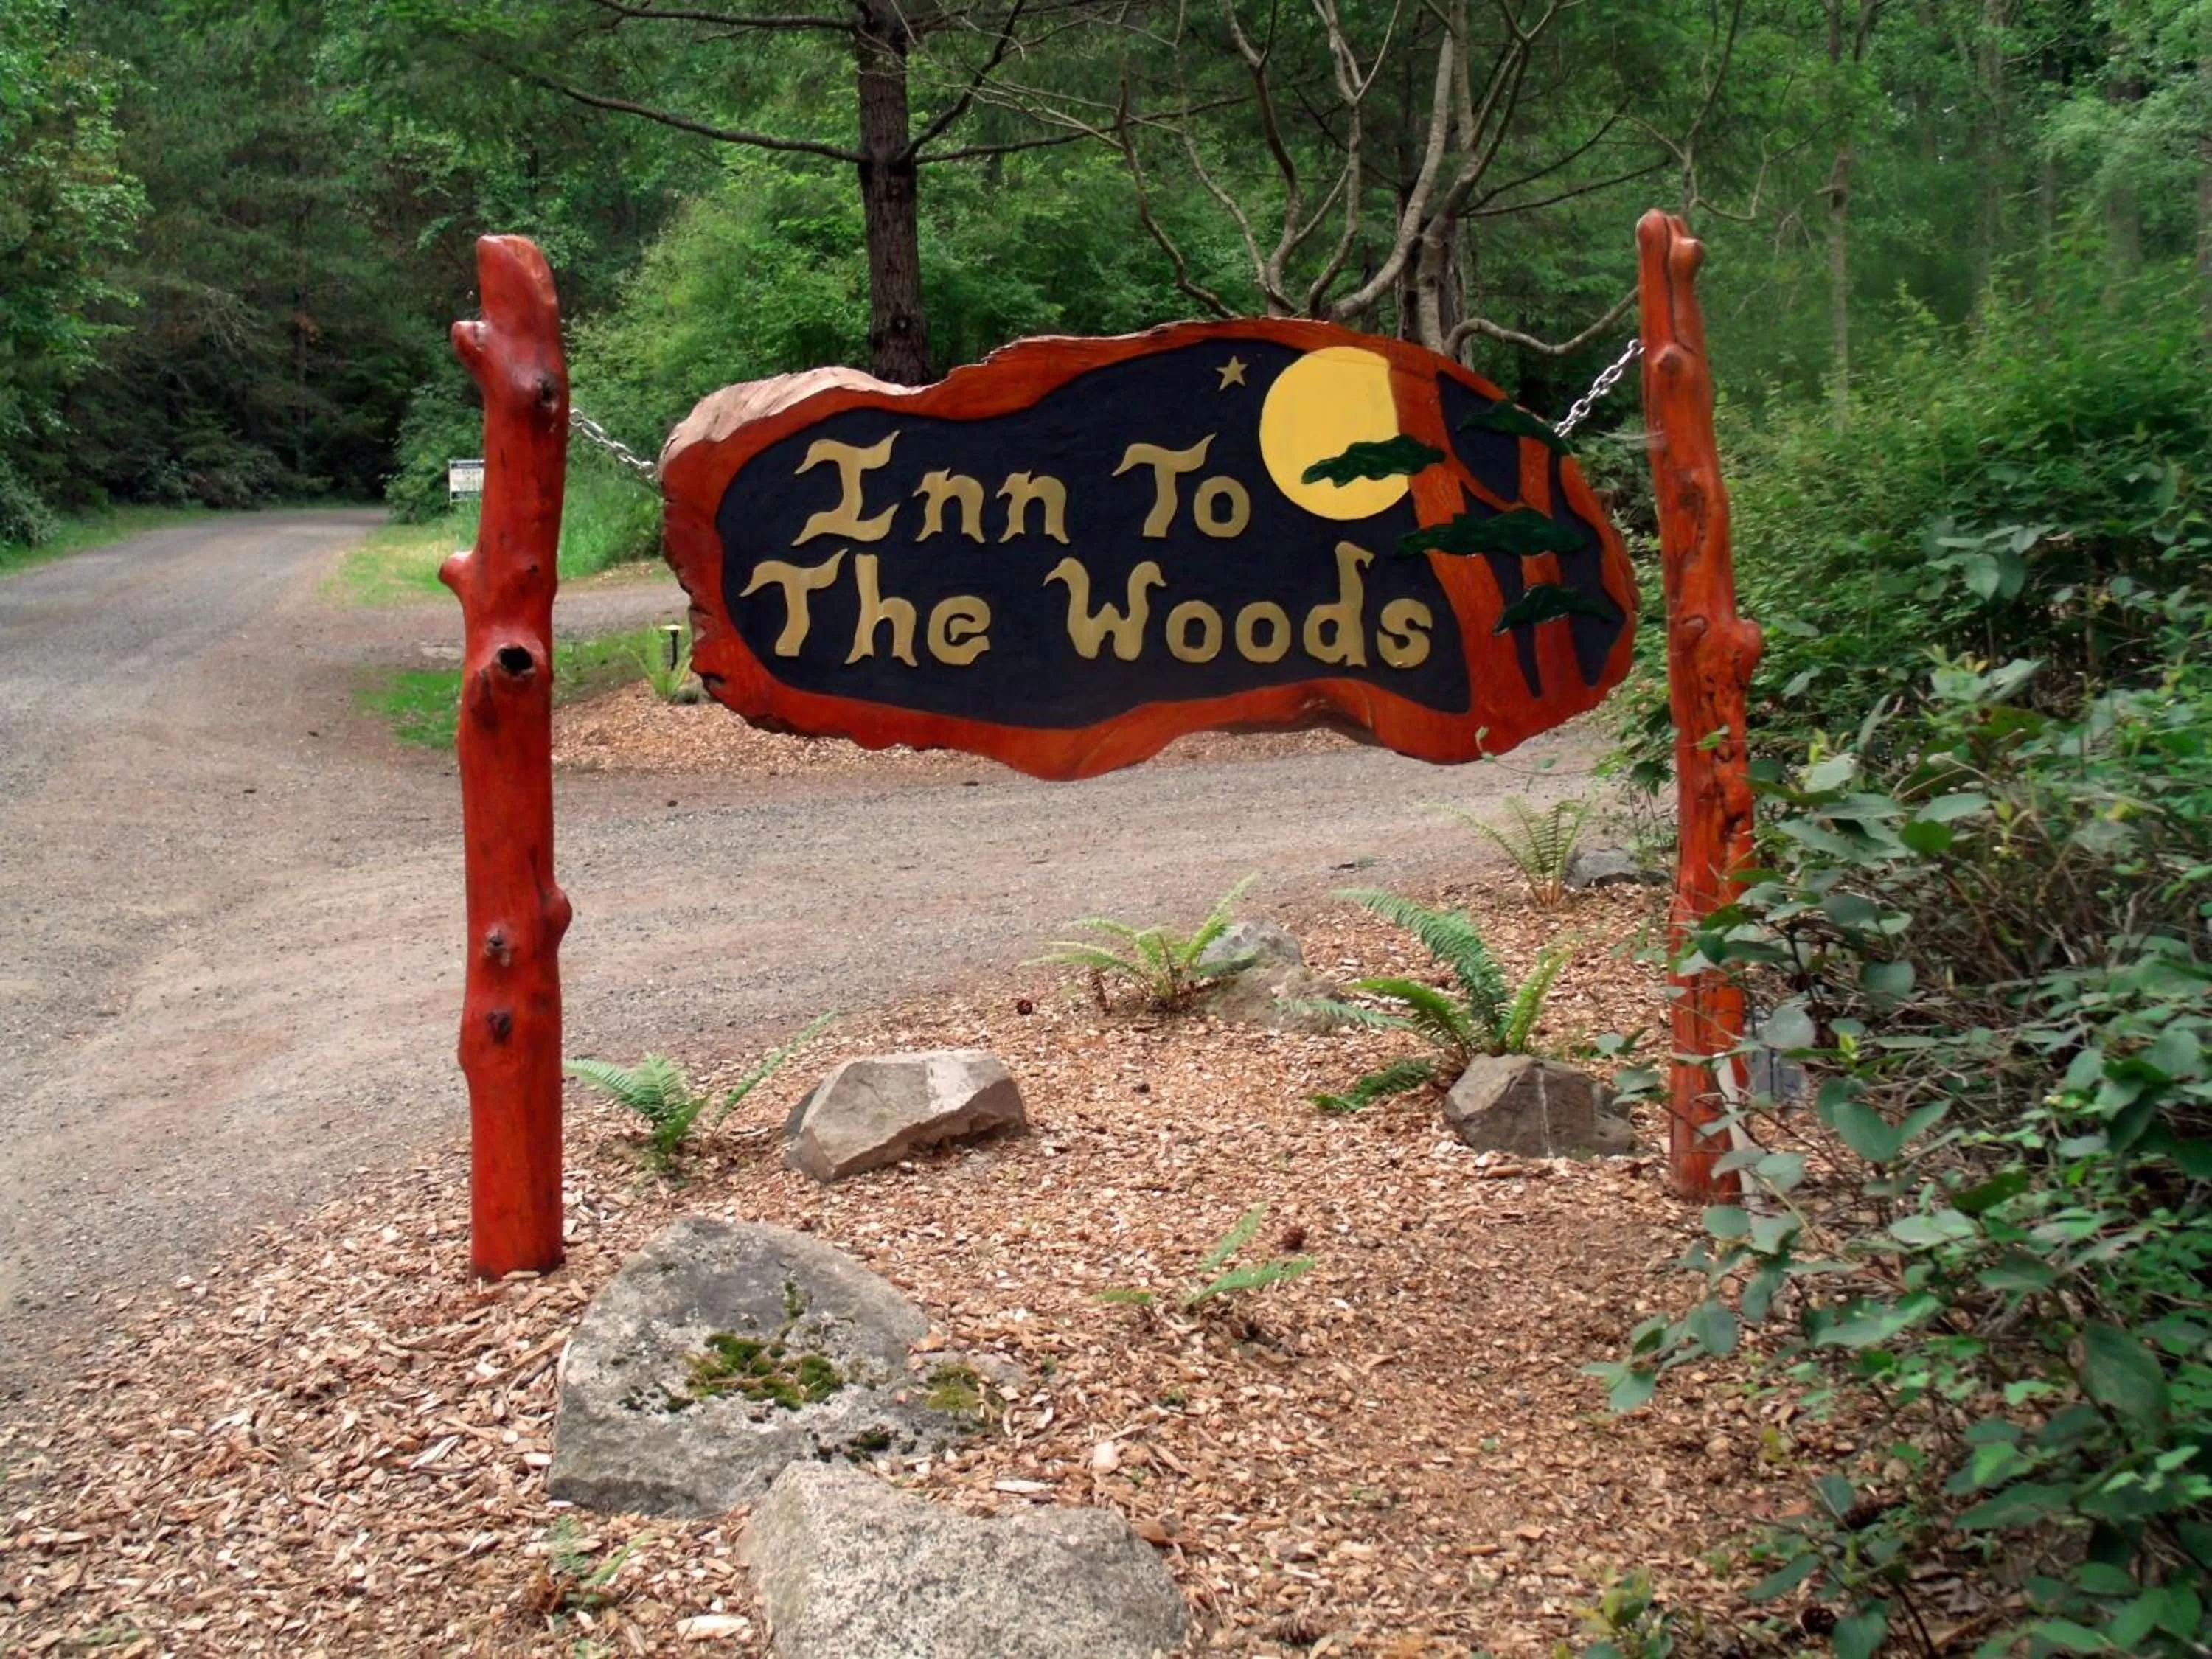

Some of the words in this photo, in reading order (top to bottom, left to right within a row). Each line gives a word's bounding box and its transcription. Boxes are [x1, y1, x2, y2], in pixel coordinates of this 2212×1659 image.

[791, 429, 1071, 546] Inn
[1112, 432, 1251, 538] To
[739, 547, 992, 667] The
[1043, 541, 1433, 668] Woods
